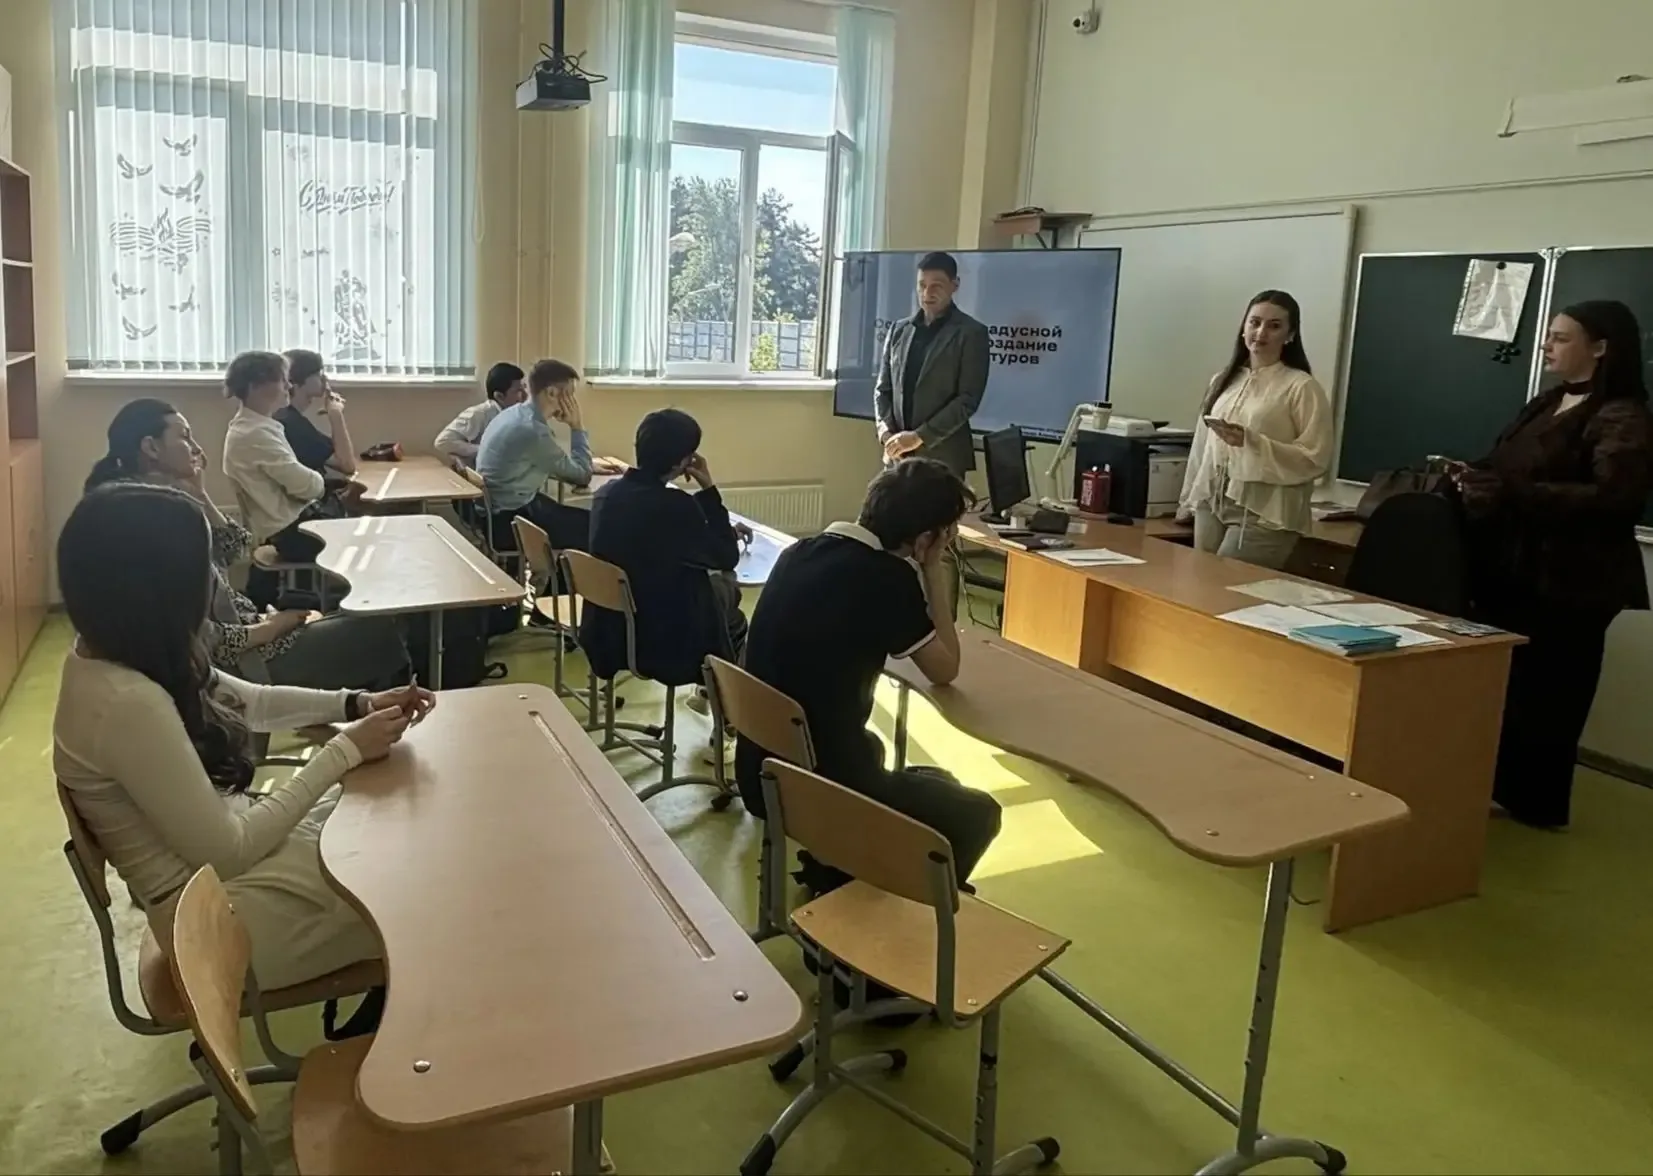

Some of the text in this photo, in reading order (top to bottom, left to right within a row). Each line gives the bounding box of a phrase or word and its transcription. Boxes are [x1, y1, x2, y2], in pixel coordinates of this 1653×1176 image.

[988, 325, 1062, 339] адусной
[988, 339, 1058, 352] оздание
[989, 352, 1040, 366] туров
